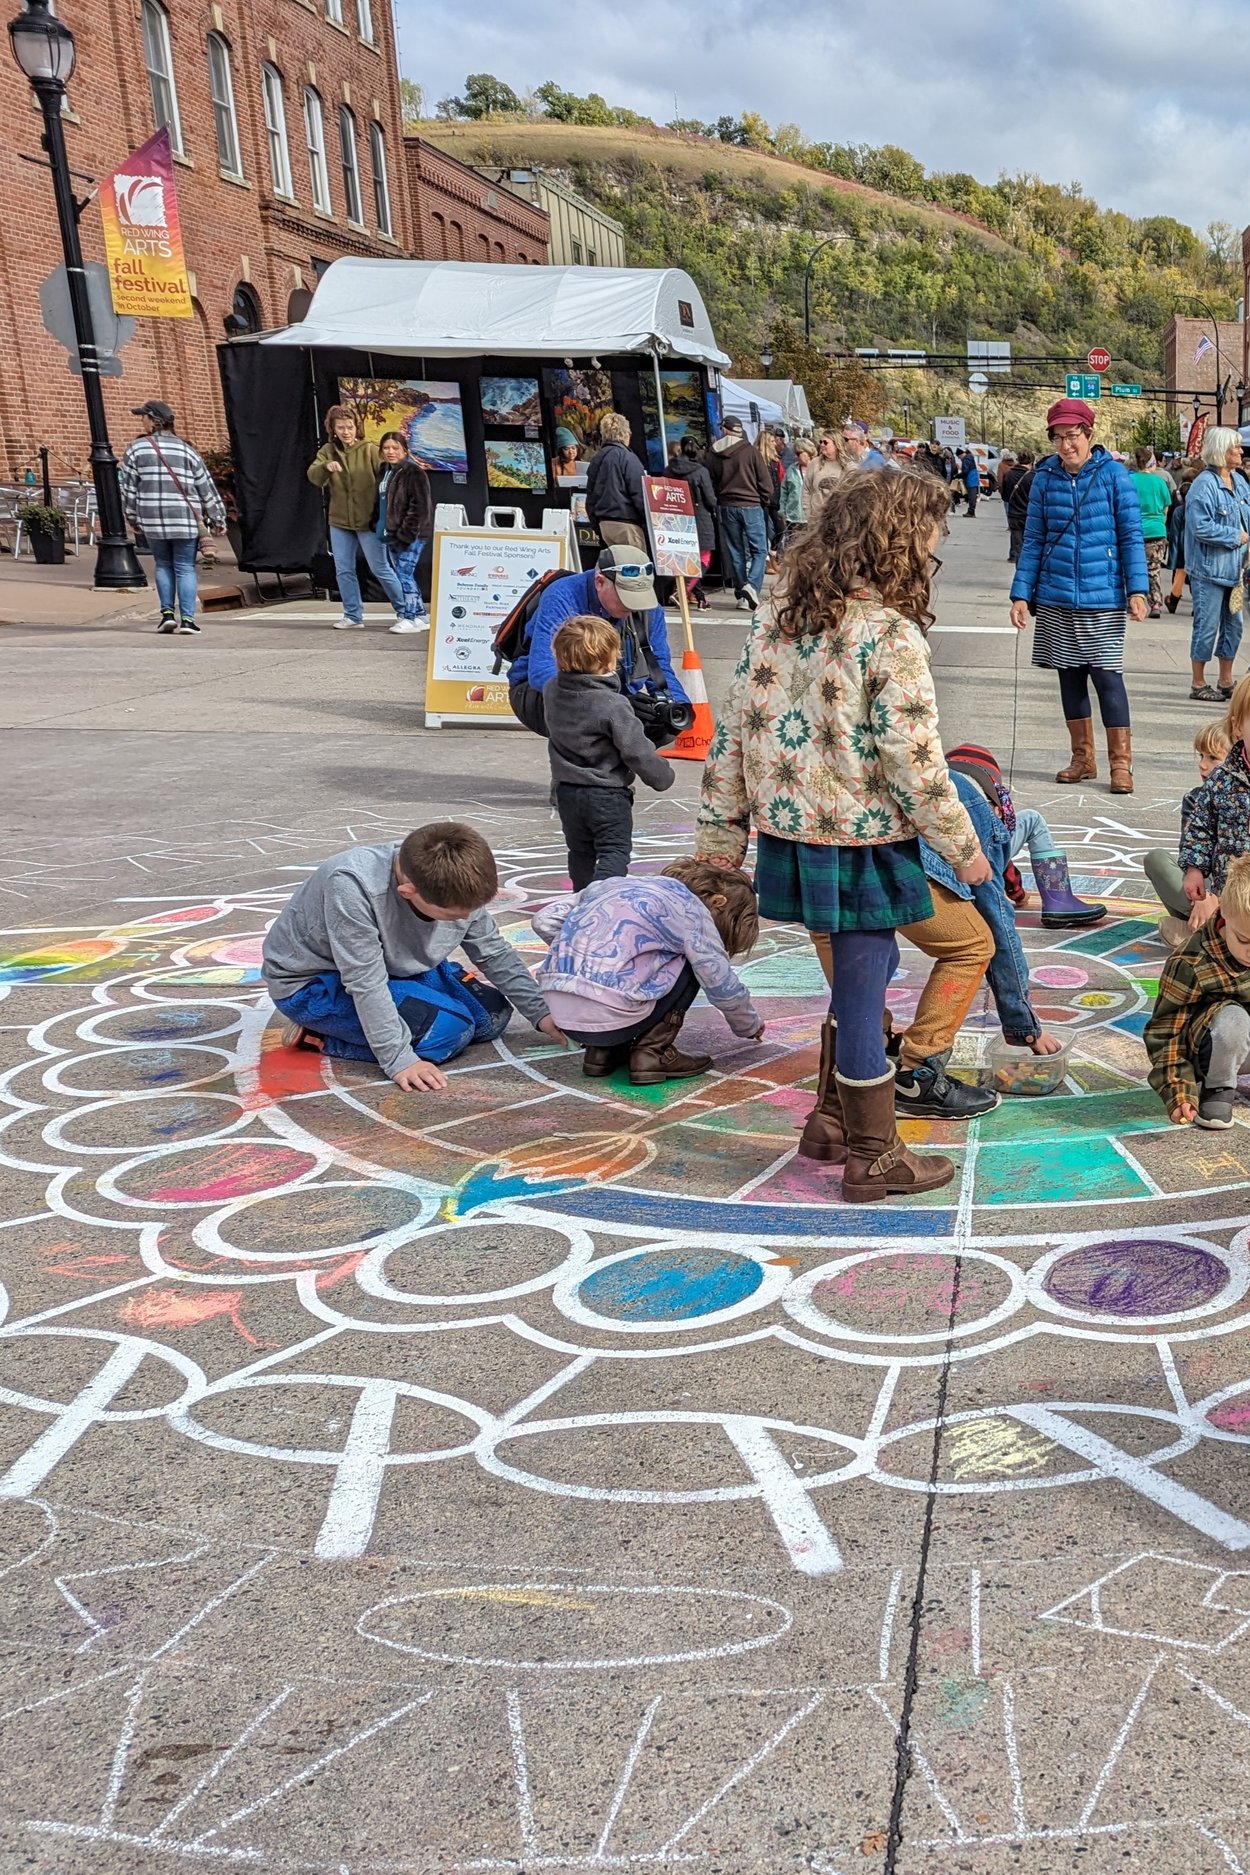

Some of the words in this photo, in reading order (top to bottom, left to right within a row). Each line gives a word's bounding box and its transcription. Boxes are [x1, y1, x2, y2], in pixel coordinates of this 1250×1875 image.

[121, 227, 140, 236] RED
[140, 228, 170, 239] WING
[124, 239, 172, 258] ARTS
[113, 258, 145, 275] fall
[114, 275, 187, 294] festival
[116, 294, 146, 303] second
[147, 296, 187, 304] weekend
[117, 302, 125, 310] in
[127, 303, 160, 312] October
[1090, 355, 1109, 364] STOP
[666, 492, 686, 504] ARTS
[668, 535, 680, 544] Xcel
[680, 536, 697, 548] Energy
[478, 550, 502, 558] Festival
[520, 546, 536, 554] Wing
[486, 692, 510, 703] ART
